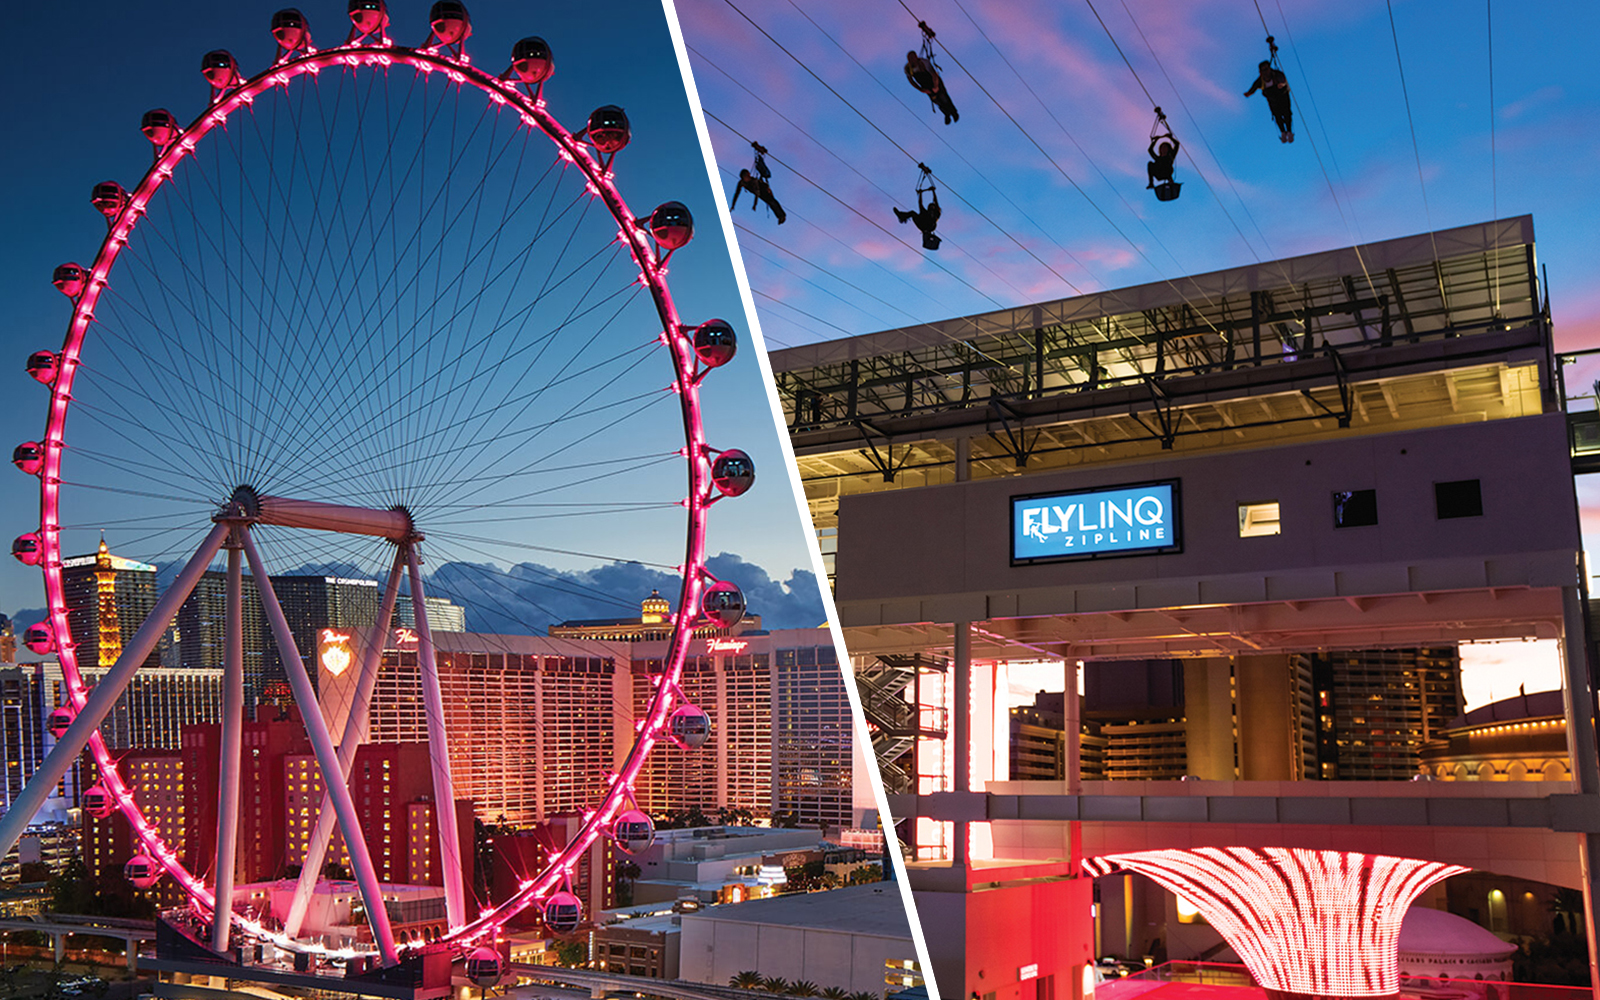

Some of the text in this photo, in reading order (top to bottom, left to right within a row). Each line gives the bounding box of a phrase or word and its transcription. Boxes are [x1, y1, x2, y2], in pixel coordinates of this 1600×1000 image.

[1022, 495, 1164, 537] FLYLINQ
[1064, 527, 1166, 548] ZIPLINE
[706, 638, 749, 654] Flamingo
